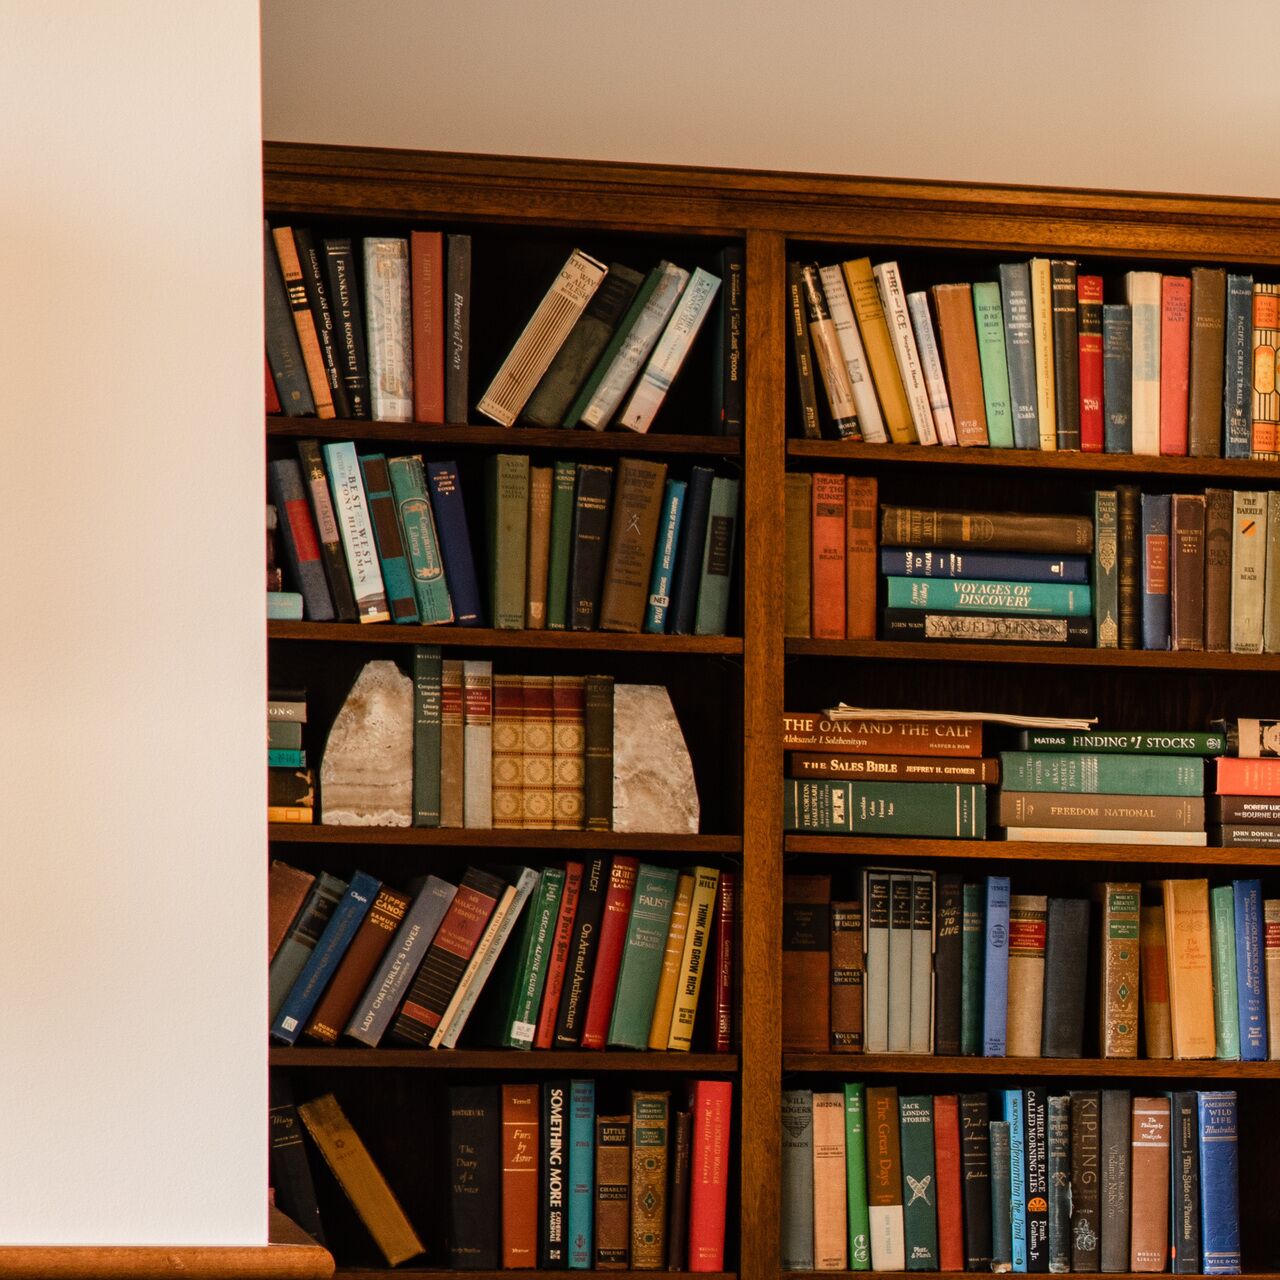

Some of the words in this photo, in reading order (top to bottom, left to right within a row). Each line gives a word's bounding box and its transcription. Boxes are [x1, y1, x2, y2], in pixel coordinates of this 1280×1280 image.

[336, 259, 350, 306] FRANKLIN
[344, 321, 357, 372] ROOSEVELT
[339, 481, 353, 512] TONY
[346, 514, 367, 583] HILLERMAN
[953, 582, 1010, 594] VOYAGES
[1013, 584, 1032, 595] OF
[959, 594, 1032, 607] DISCOVERY
[930, 621, 987, 634] SAMUEL
[989, 621, 1063, 636] JOHNSON
[783, 719, 813, 732] THE
[819, 720, 851, 734] OAK
[858, 721, 893, 735] AND
[898, 723, 929, 736] THE
[934, 724, 973, 738] CALF
[1033, 736, 1066, 745] MATRAS
[1072, 736, 1128, 748] FINDING
[1146, 737, 1196, 749] STOCKS
[803, 761, 827, 770] THE
[830, 758, 863, 773] SALES
[865, 760, 898, 774] BIBLE
[1050, 806, 1099, 817] FREEDOM
[1104, 807, 1156, 818] NATIONAL
[1241, 811, 1271, 819] BOURNE
[588, 858, 602, 892] TILLICH
[638, 894, 670, 908] FAUST
[695, 902, 708, 928] THINK
[580, 922, 592, 939] On
[692, 928, 704, 947] AND
[576, 940, 589, 955] Art
[574, 954, 585, 972] and
[688, 948, 701, 974] GROW
[359, 1009, 377, 1032] LADY
[370, 951, 407, 1010] CHATTERLEY'S
[401, 923, 421, 952] LOVER
[684, 974, 697, 995] RICH
[565, 972, 583, 1030] Architecture
[877, 1097, 889, 1121] The
[902, 1109, 930, 1117] LONDON
[1027, 1090, 1035, 1125] CALLED
[549, 1088, 563, 1164] SOMETHING
[1036, 1103, 1044, 1138] WHERE
[1210, 1116, 1232, 1124] LIFE
[878, 1124, 890, 1155] Great
[1028, 1126, 1036, 1170] MORNING
[1082, 1099, 1097, 1184] KIPLING
[879, 1157, 892, 1186] Days
[1037, 1163, 1045, 1192] PLACE
[549, 1166, 561, 1208] MORE
[1029, 1173, 1037, 1192] LIES
[1039, 1219, 1047, 1240] Frank
